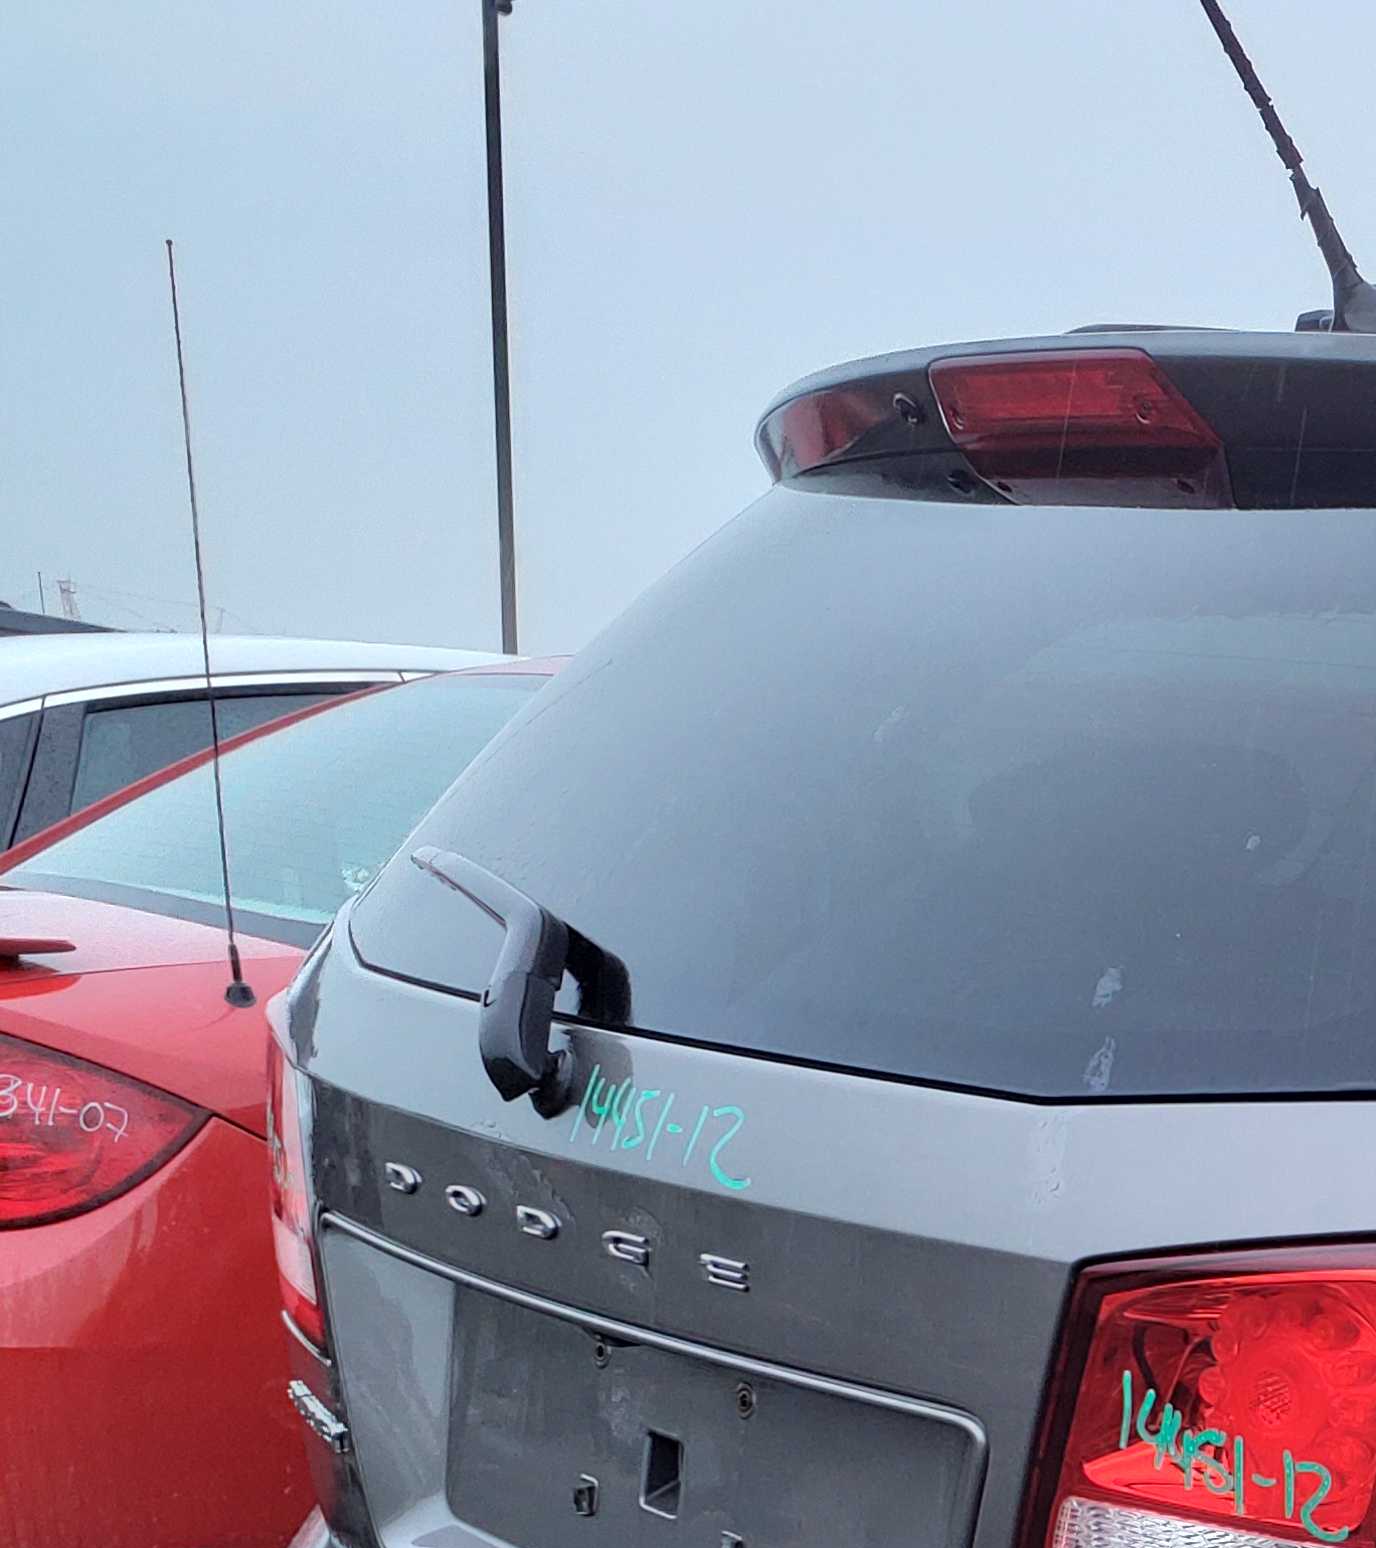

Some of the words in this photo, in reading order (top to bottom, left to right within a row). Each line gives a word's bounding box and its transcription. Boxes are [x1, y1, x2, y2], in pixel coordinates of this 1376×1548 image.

[568, 1063, 752, 1190] 14451-12
[384, 1162, 750, 1292] DODGE
[1118, 1369, 1350, 1543] 14451-12
